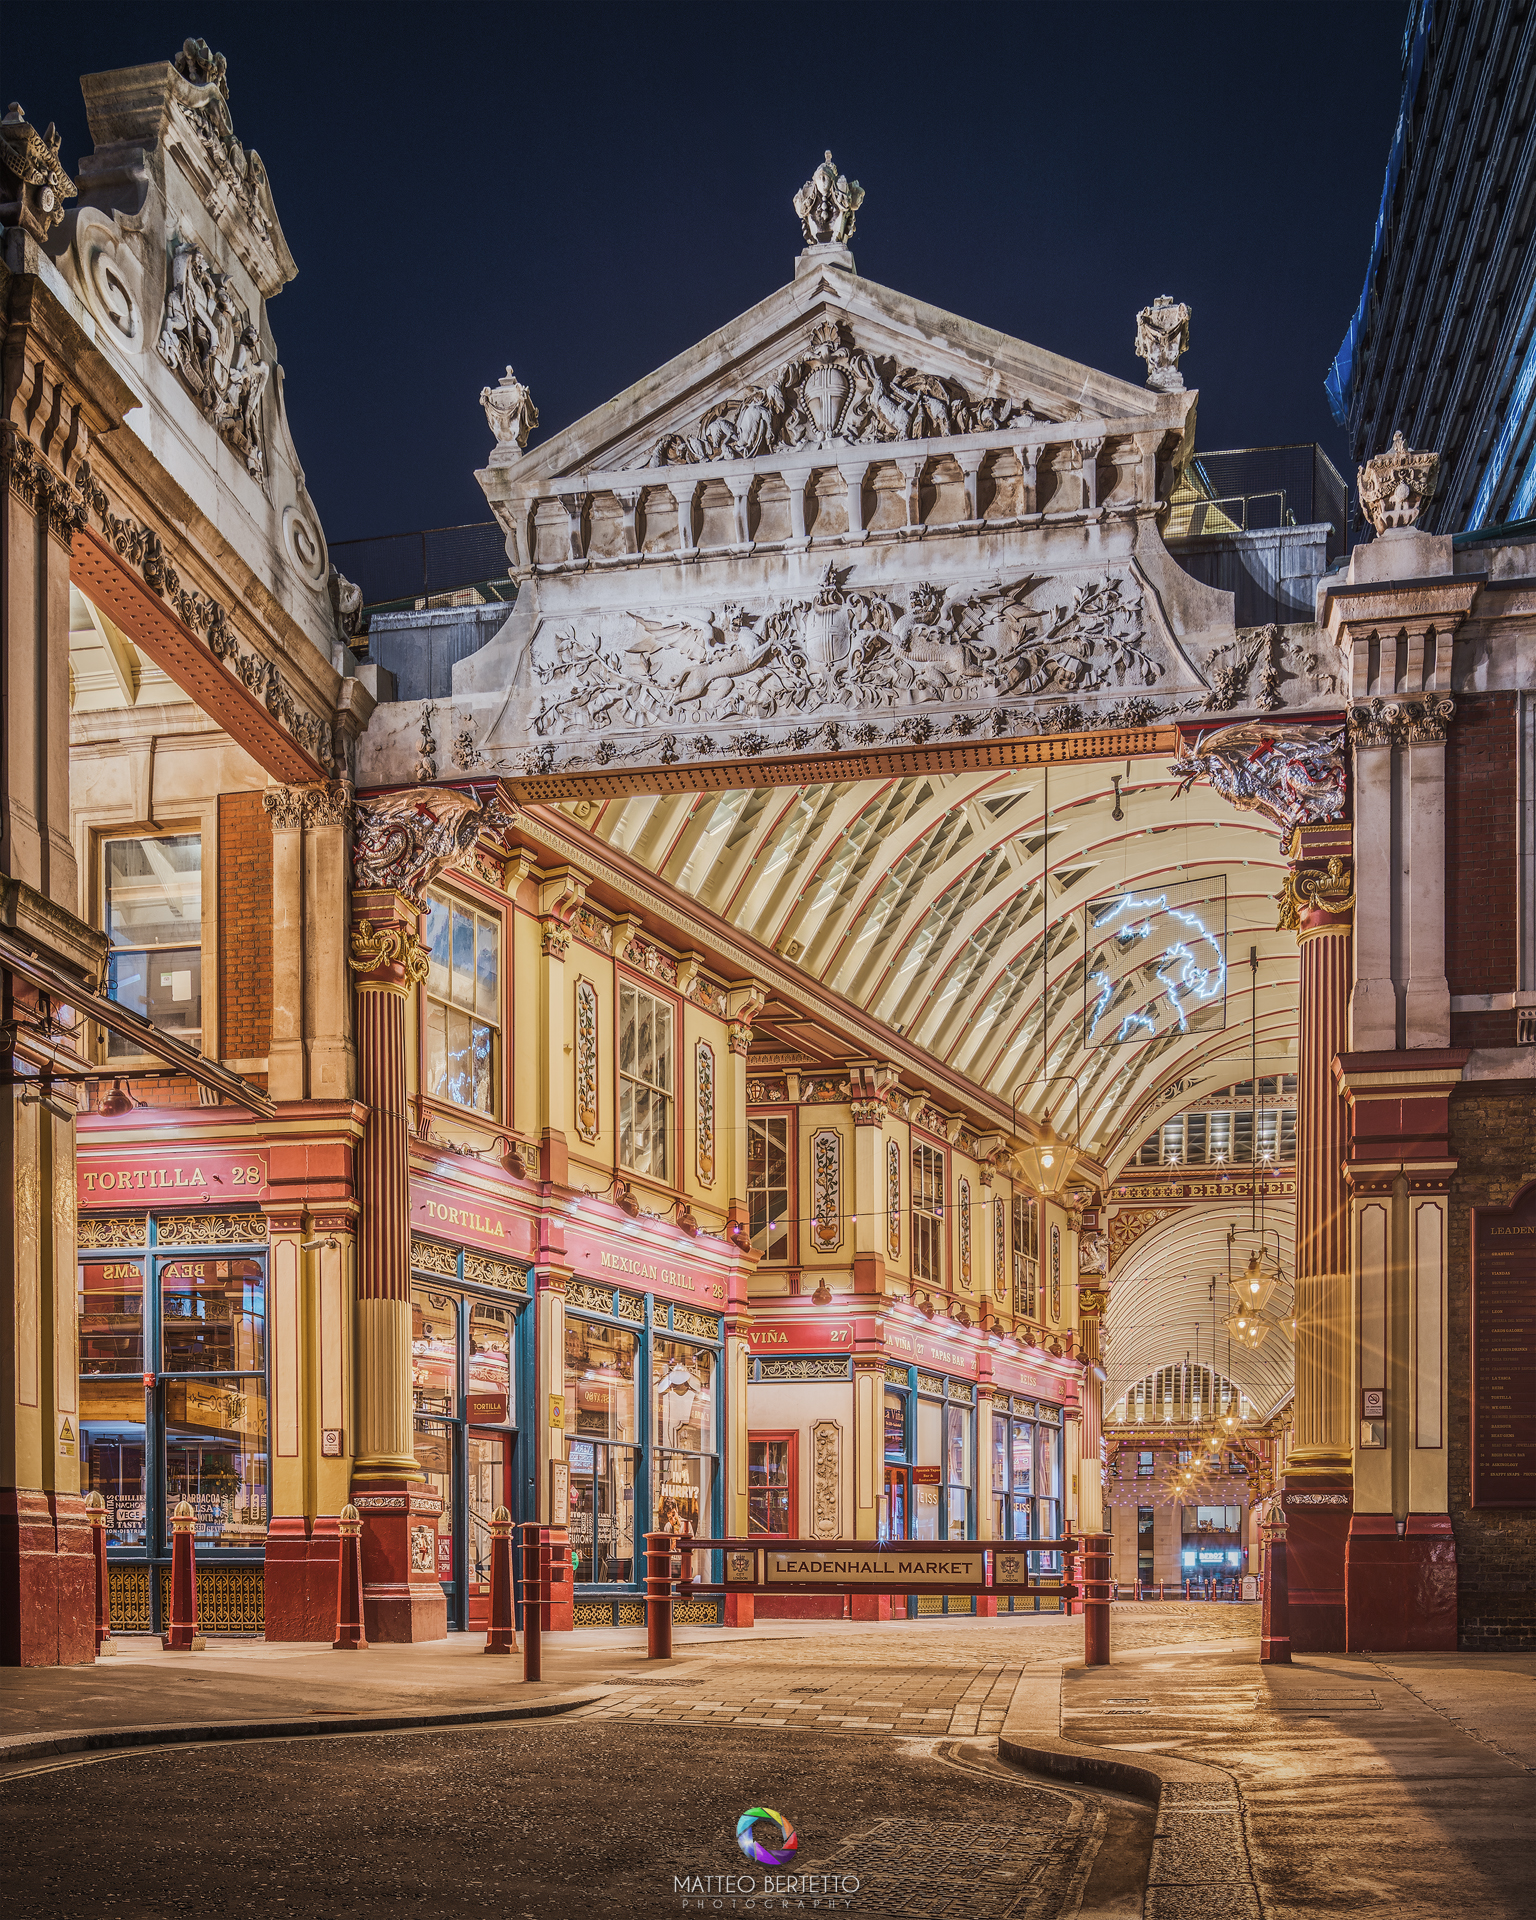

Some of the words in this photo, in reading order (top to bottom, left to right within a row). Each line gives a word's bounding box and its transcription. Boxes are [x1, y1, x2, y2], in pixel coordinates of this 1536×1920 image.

[84, 1167, 207, 1190] TORTILLA
[231, 1166, 260, 1184] 28
[1188, 1181, 1296, 1197] ERECTED
[426, 1200, 505, 1238] TORTILLA
[1490, 1226, 1536, 1235] LEADEN
[600, 1251, 658, 1280] MEXICAN
[661, 1269, 695, 1291] GRILL
[712, 1284, 724, 1299] 28
[750, 1330, 788, 1344] VIÑA
[830, 1330, 848, 1342] 27
[884, 1333, 894, 1346] LA
[894, 1336, 911, 1352] VIÑA
[917, 1344, 924, 1355] 27
[931, 1348, 951, 1363] TAPAS
[952, 1354, 964, 1367] BAR
[1020, 1374, 1037, 1387] REISS
[182, 1494, 220, 1503] BARBACOA
[661, 1484, 699, 1498] HURRY?
[776, 1561, 894, 1574] LEADENHALL
[898, 1562, 972, 1575] MARKET
